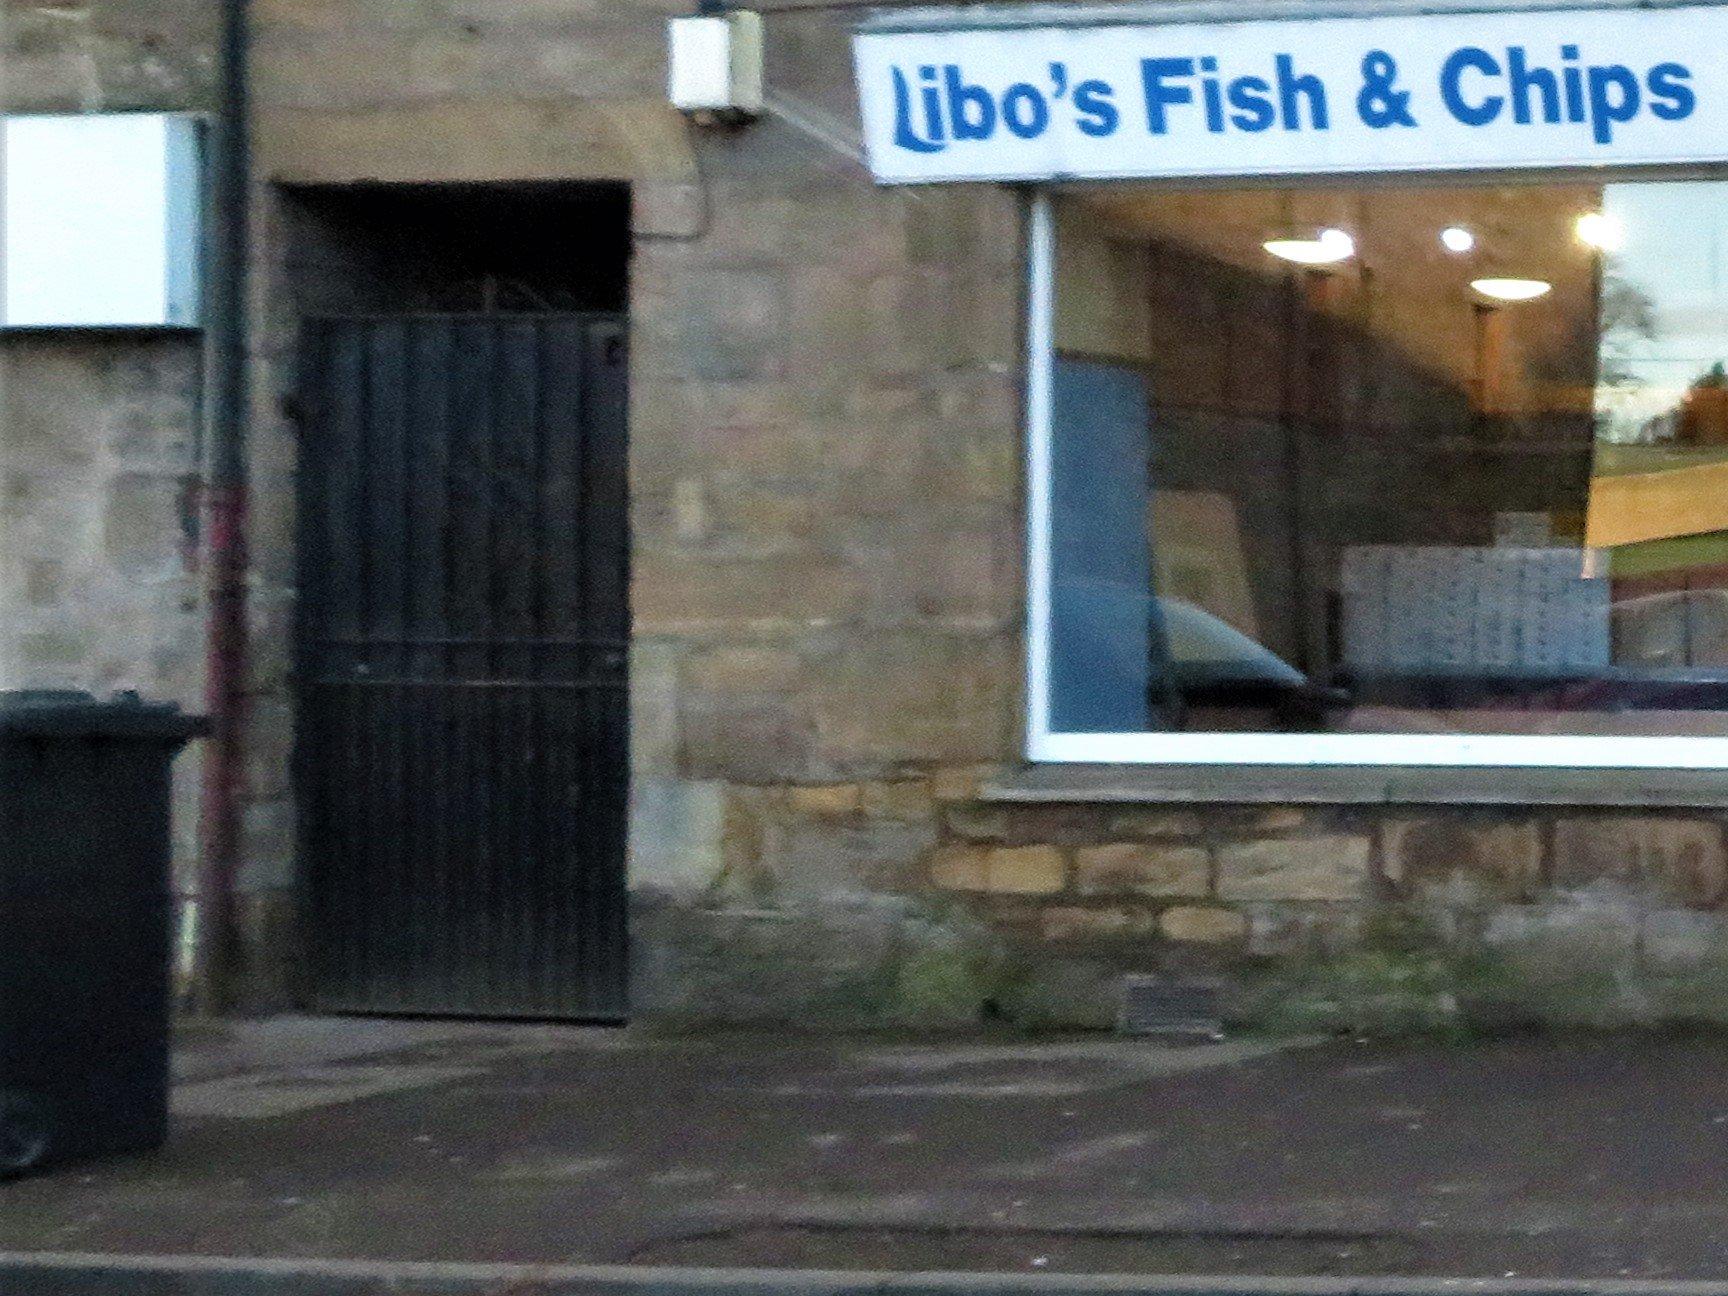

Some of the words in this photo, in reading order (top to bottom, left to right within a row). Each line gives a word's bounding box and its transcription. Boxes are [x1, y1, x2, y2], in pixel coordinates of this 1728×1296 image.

[889, 60, 1121, 156] Libo's
[1139, 52, 1332, 138] Fish
[1355, 48, 1419, 130] &
[1437, 43, 1699, 147] Chips
